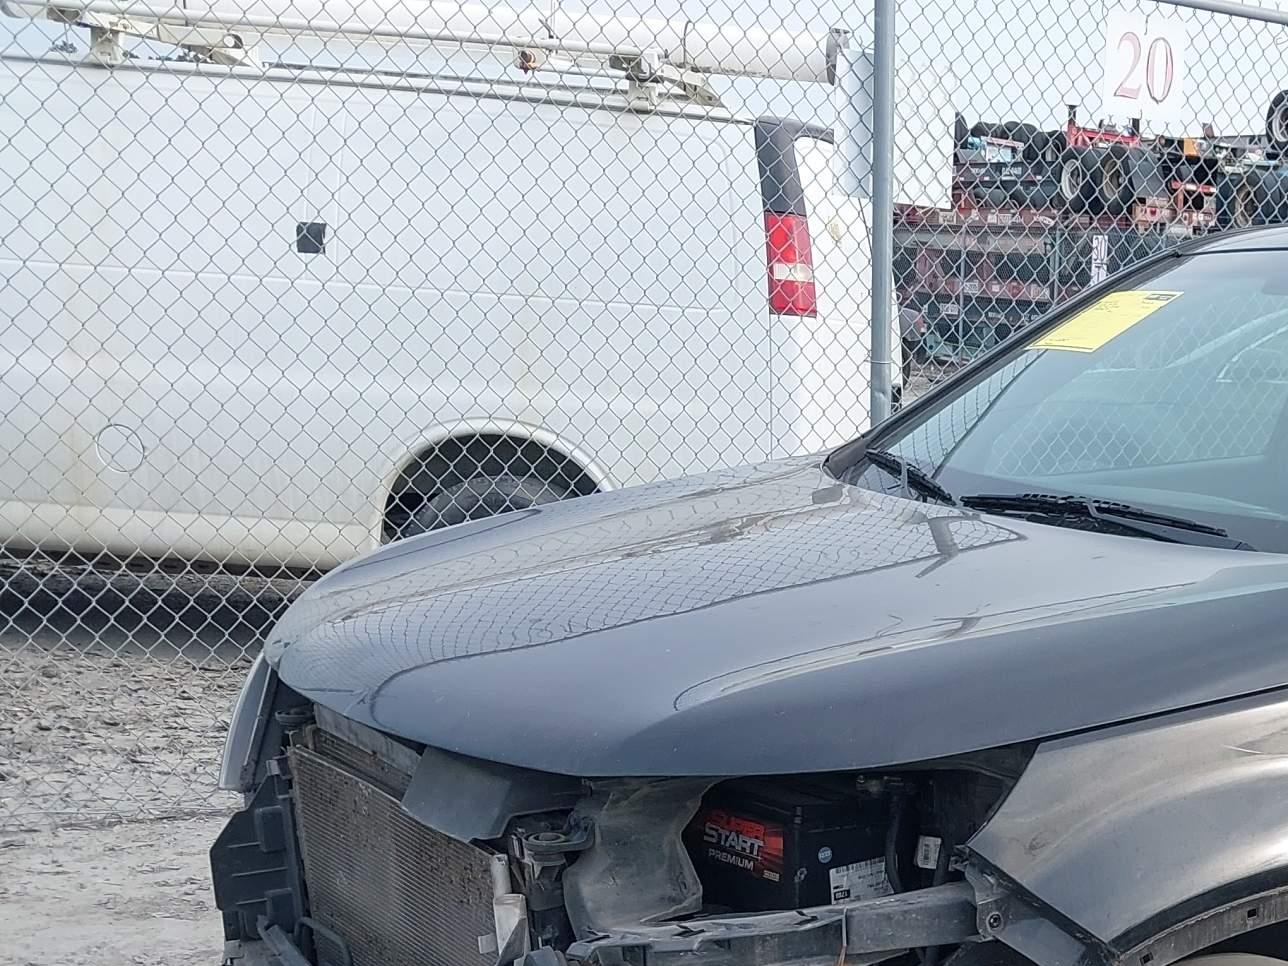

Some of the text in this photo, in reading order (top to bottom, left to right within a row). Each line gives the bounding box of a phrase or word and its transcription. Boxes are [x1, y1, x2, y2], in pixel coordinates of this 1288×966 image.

[1113, 31, 1174, 104] 20
[703, 822, 765, 856] START
[708, 848, 755, 871] PREMIUM
